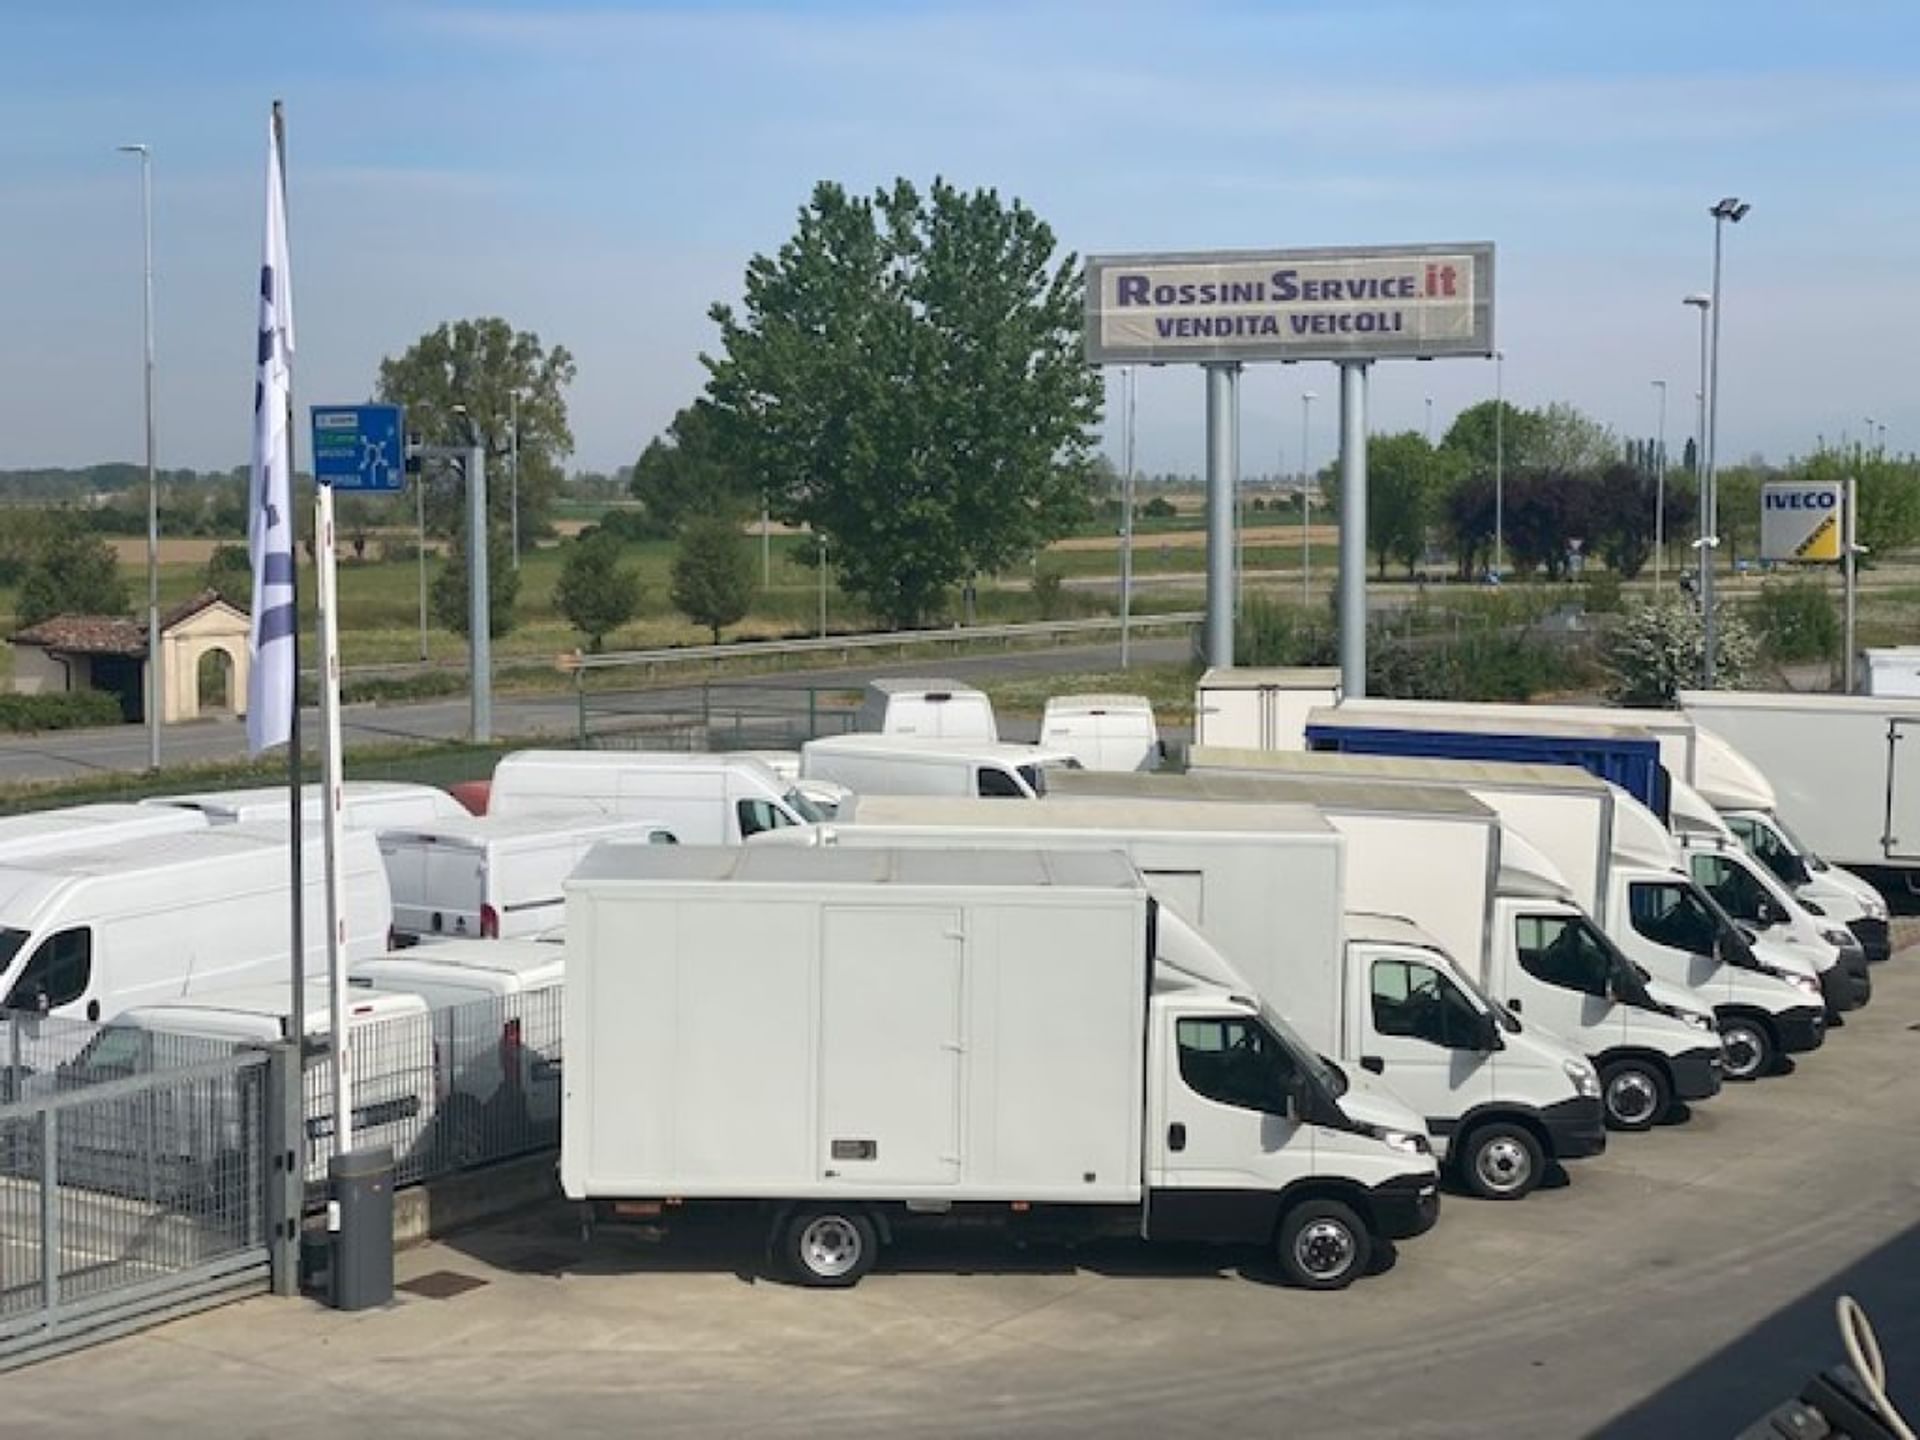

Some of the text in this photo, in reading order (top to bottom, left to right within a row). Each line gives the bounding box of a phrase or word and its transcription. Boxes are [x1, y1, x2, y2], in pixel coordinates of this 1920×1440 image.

[1155, 312, 1402, 337] VENDITA VEICOLI
[1765, 492, 1836, 509] IVECO
